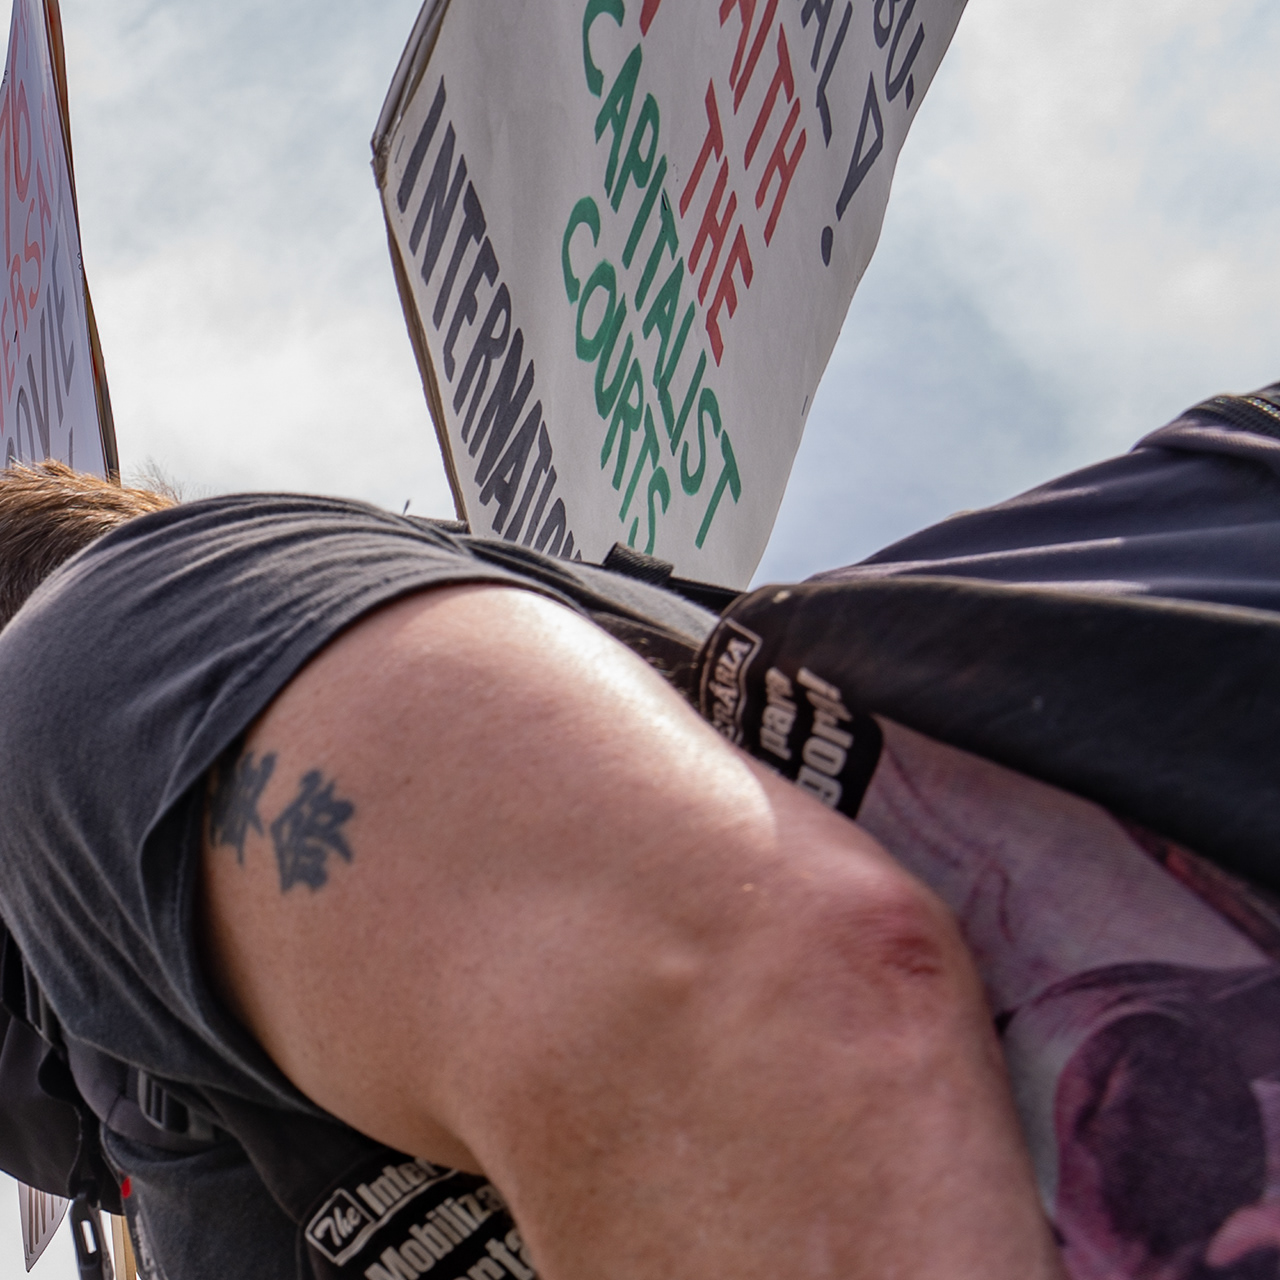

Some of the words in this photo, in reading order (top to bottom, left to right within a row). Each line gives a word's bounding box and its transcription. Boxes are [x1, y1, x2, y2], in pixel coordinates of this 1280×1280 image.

[396, 75, 582, 562] INTERNATIO
[561, 195, 671, 556] COURTS
[582, 0, 741, 550] CAPITALIST
[679, 77, 753, 367] THE
[313, 1206, 362, 1248] The
